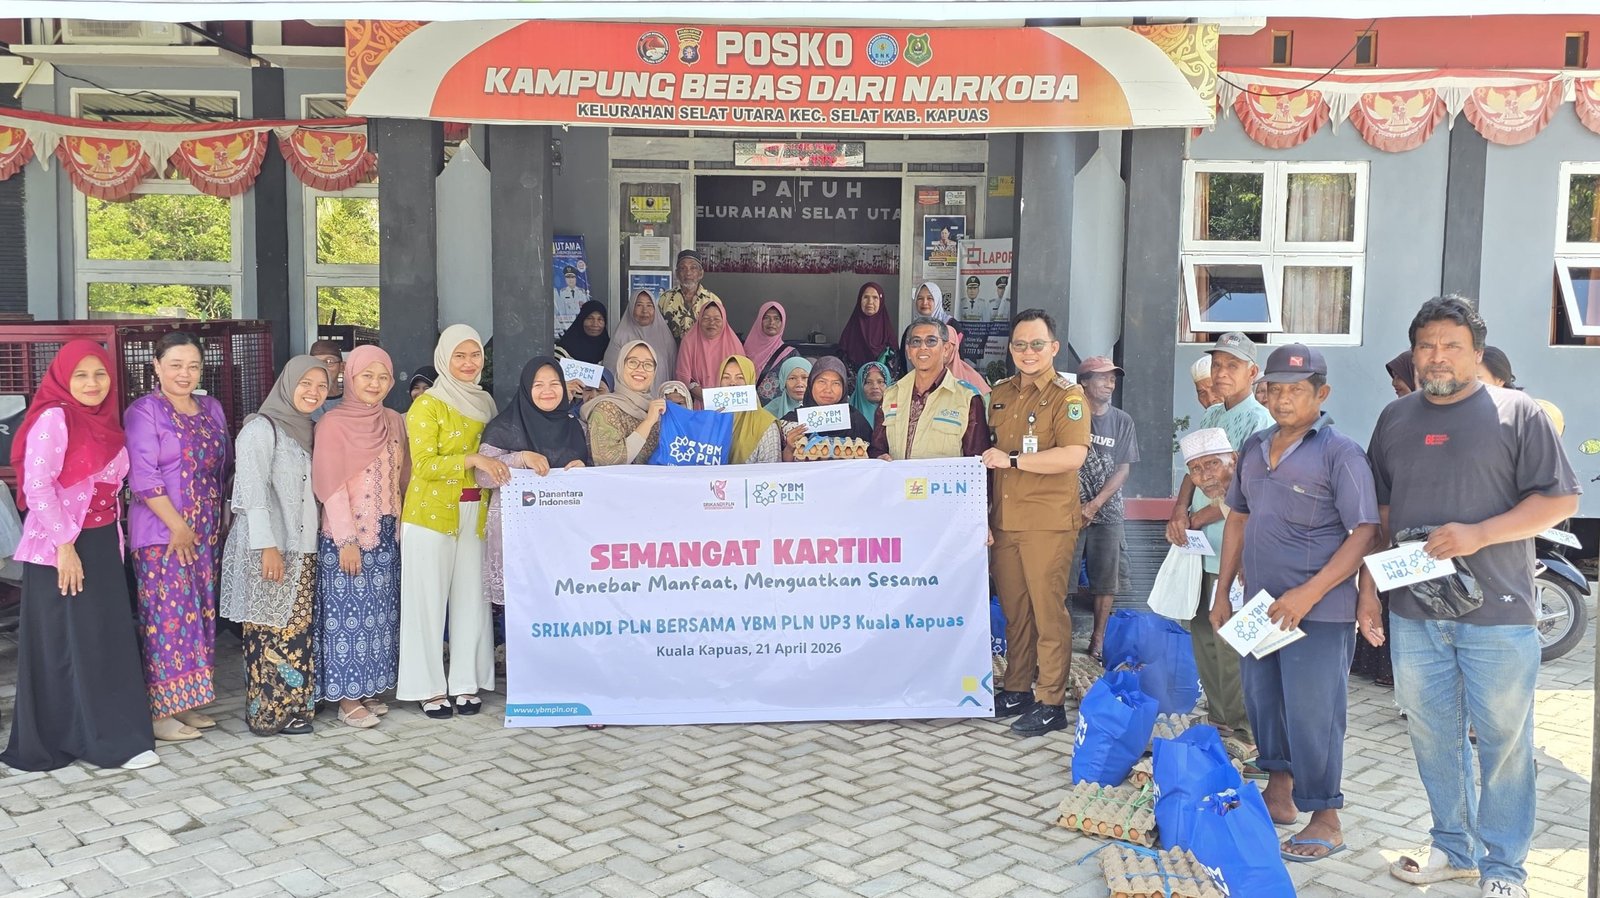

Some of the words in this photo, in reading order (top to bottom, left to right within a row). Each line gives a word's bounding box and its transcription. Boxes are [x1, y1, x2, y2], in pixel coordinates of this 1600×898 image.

[716, 31, 854, 68] POSKO
[484, 67, 675, 100] KAMPUNG
[680, 73, 803, 101] BEBAS
[807, 75, 897, 102] DARI
[901, 75, 1080, 103] NARKOBA
[577, 103, 676, 119] KELURAHAN
[678, 105, 729, 121] SELAT
[732, 106, 787, 122] UTARA
[789, 107, 827, 122] KEC.
[831, 108, 879, 123] SELAT
[883, 108, 921, 123] KAB.
[925, 108, 990, 123] KAPUAS
[752, 180, 862, 198] PATUH
[801, 207, 859, 220] SELAT
[555, 242, 582, 251] UTAMA
[825, 416, 842, 424] PLN
[697, 442, 723, 456] YBM
[696, 453, 722, 466] PLN
[538, 489, 584, 499] Danantara
[778, 483, 804, 492] YBM
[930, 482, 967, 494] PLN
[538, 498, 581, 506] Indonesia
[780, 492, 805, 502] PLN
[590, 540, 761, 571] SEMANGAT
[773, 537, 902, 565] KARTINI
[1381, 558, 1408, 572] PLN
[1386, 567, 1413, 580] YBM
[555, 576, 642, 596] Menebar
[648, 573, 738, 592] Manfaat,
[744, 572, 861, 593] Menguatkan
[868, 572, 939, 588] Sesama
[1248, 602, 1268, 619] YBM
[531, 620, 613, 638] SRIKANDI
[618, 619, 652, 635] PLN
[656, 616, 737, 634] BERSAMA
[741, 615, 777, 631] YBM
[781, 614, 815, 631] PLN
[819, 614, 851, 630] UP3
[856, 613, 900, 630] Kuala
[905, 613, 965, 632] Kapuas
[656, 645, 695, 657] Kuala
[699, 644, 752, 659] Kapuas,
[755, 643, 771, 654] 21
[775, 642, 807, 657] April
[811, 642, 842, 654] 2026
[513, 705, 578, 714] www.ybmpln.org
